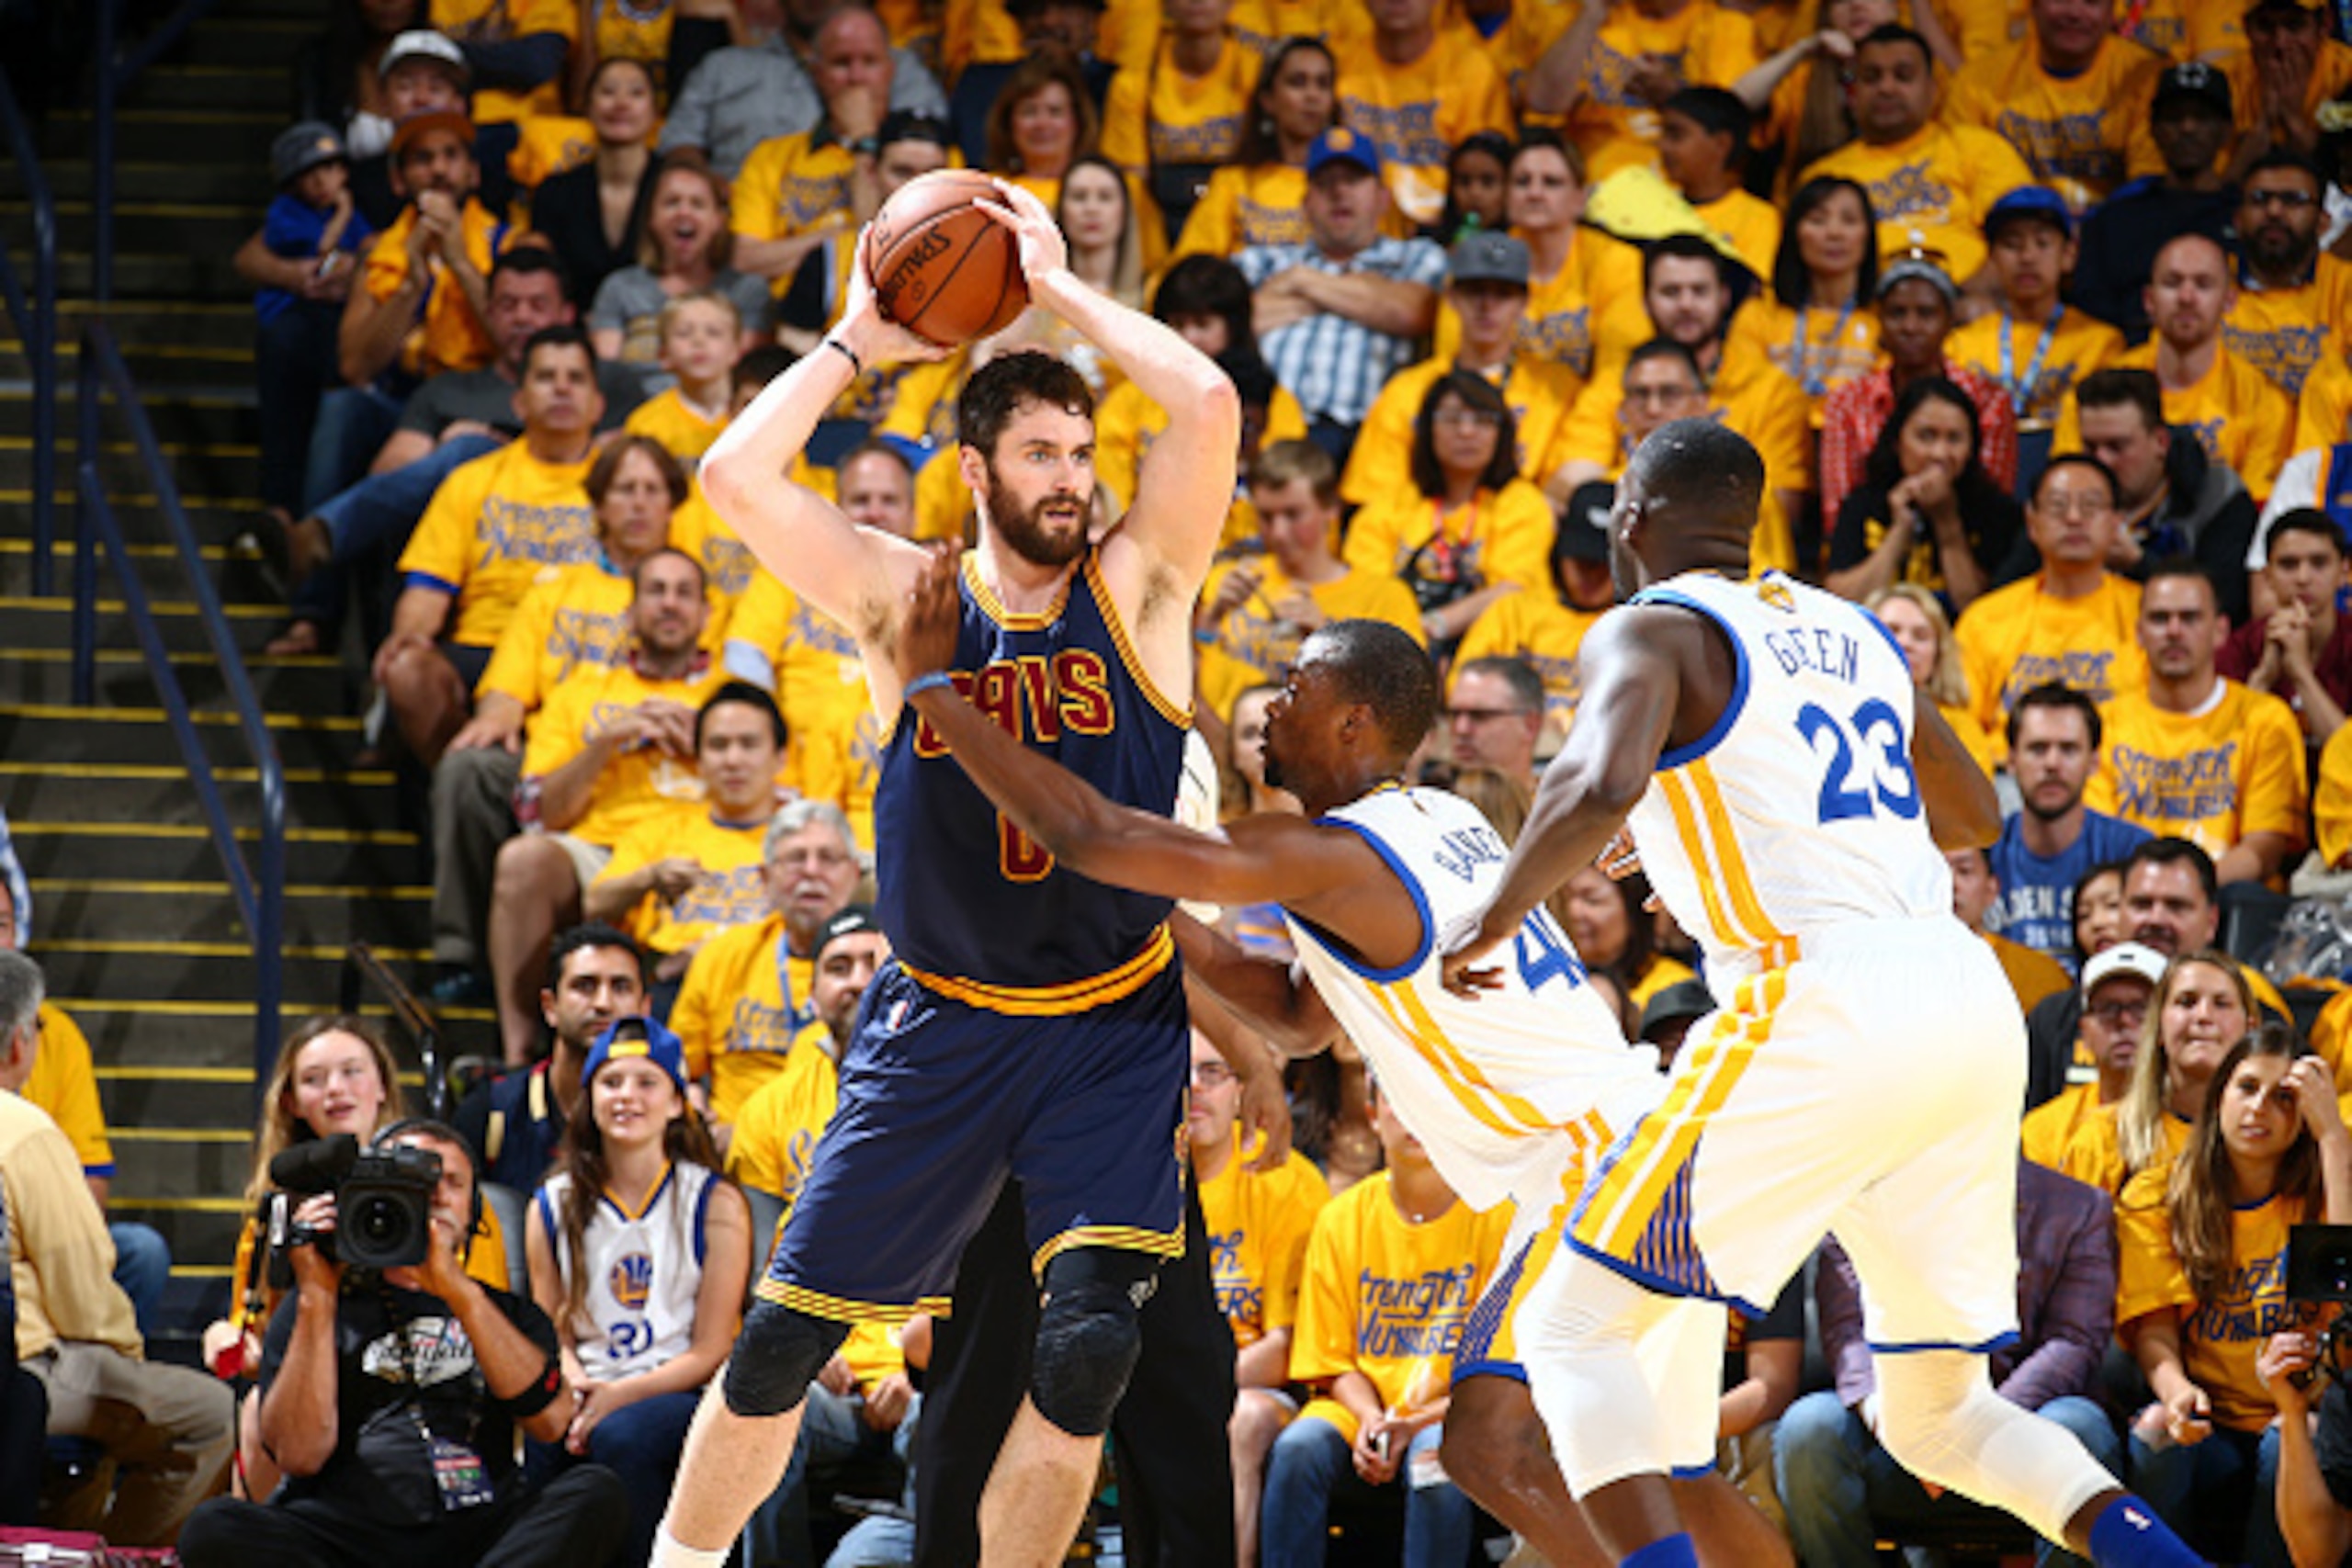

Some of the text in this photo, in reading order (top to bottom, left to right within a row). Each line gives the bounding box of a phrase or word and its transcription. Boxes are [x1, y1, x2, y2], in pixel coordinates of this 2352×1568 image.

[879, 223, 952, 299] SPALD
[1762, 626, 1859, 685] GEN
[1793, 696, 1921, 826] 23
[1514, 908, 1590, 992] 4
